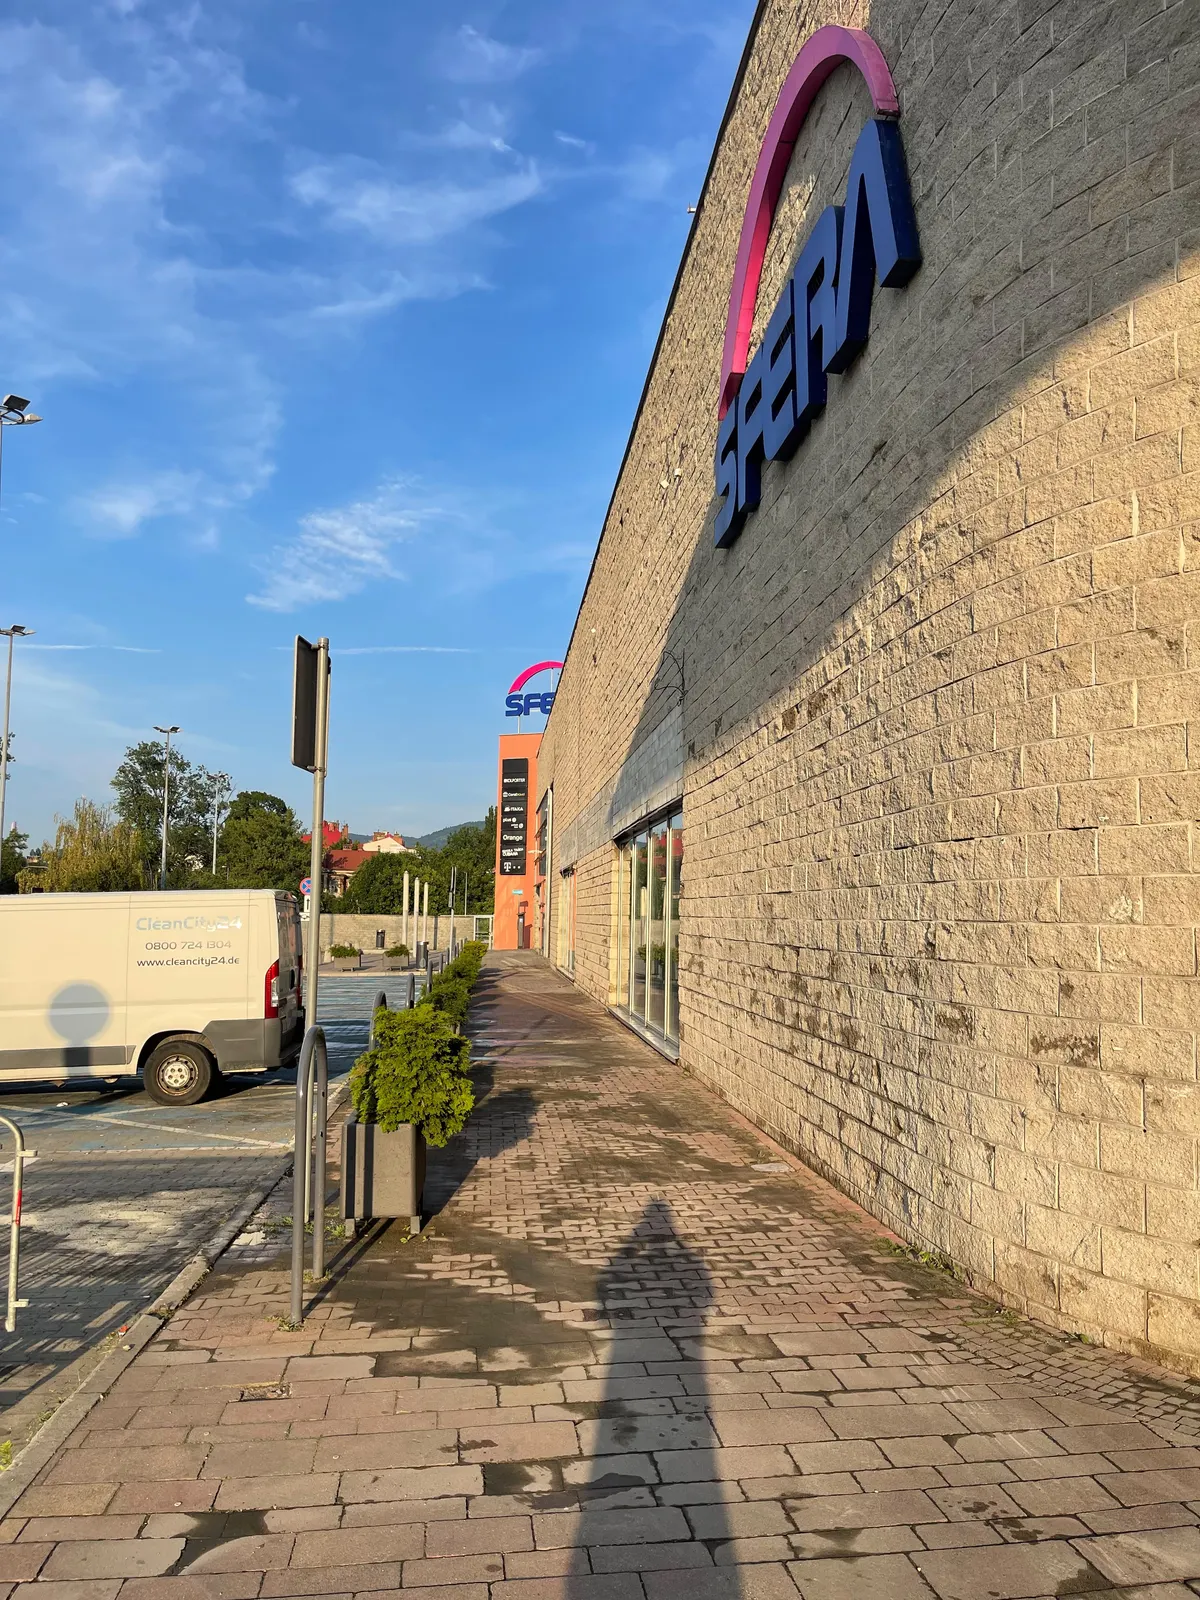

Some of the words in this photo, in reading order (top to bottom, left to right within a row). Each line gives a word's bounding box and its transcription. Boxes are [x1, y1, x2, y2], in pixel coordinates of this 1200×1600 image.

[714, 117, 922, 548] SFERA
[502, 834, 523, 842] Orange
[136, 916, 242, 932] CleanCity24
[145, 942, 177, 950] 0800
[181, 941, 202, 950] 724
[136, 956, 240, 967] www.cleancity24.de
